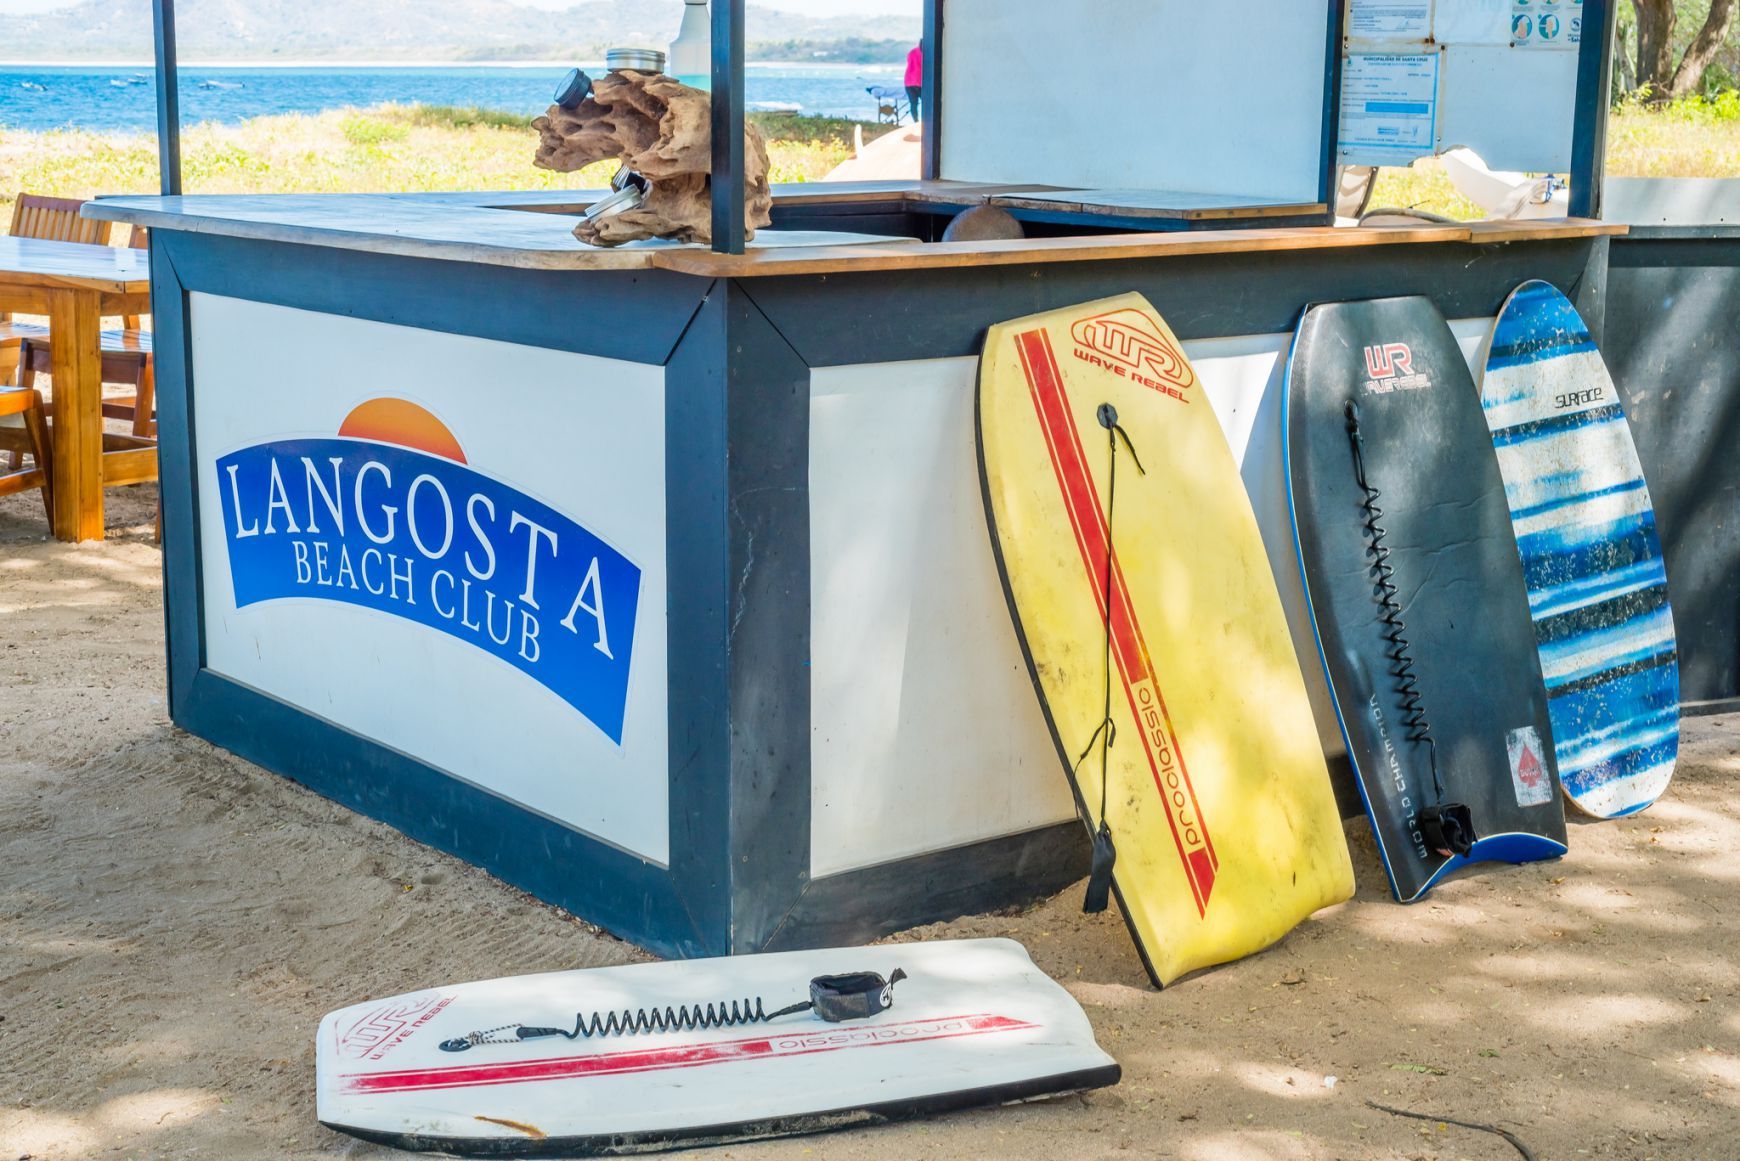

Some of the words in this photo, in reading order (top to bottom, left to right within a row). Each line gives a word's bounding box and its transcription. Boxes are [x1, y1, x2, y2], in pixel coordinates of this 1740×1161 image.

[1074, 348, 1126, 377] WAVE
[1131, 372, 1190, 404] REBEL
[226, 456, 614, 660] LANGOSTA
[292, 540, 417, 606] BEACH
[430, 569, 541, 663] CLUB
[1138, 687, 1201, 846] proclassic
[1400, 796, 1428, 859] WORLD
